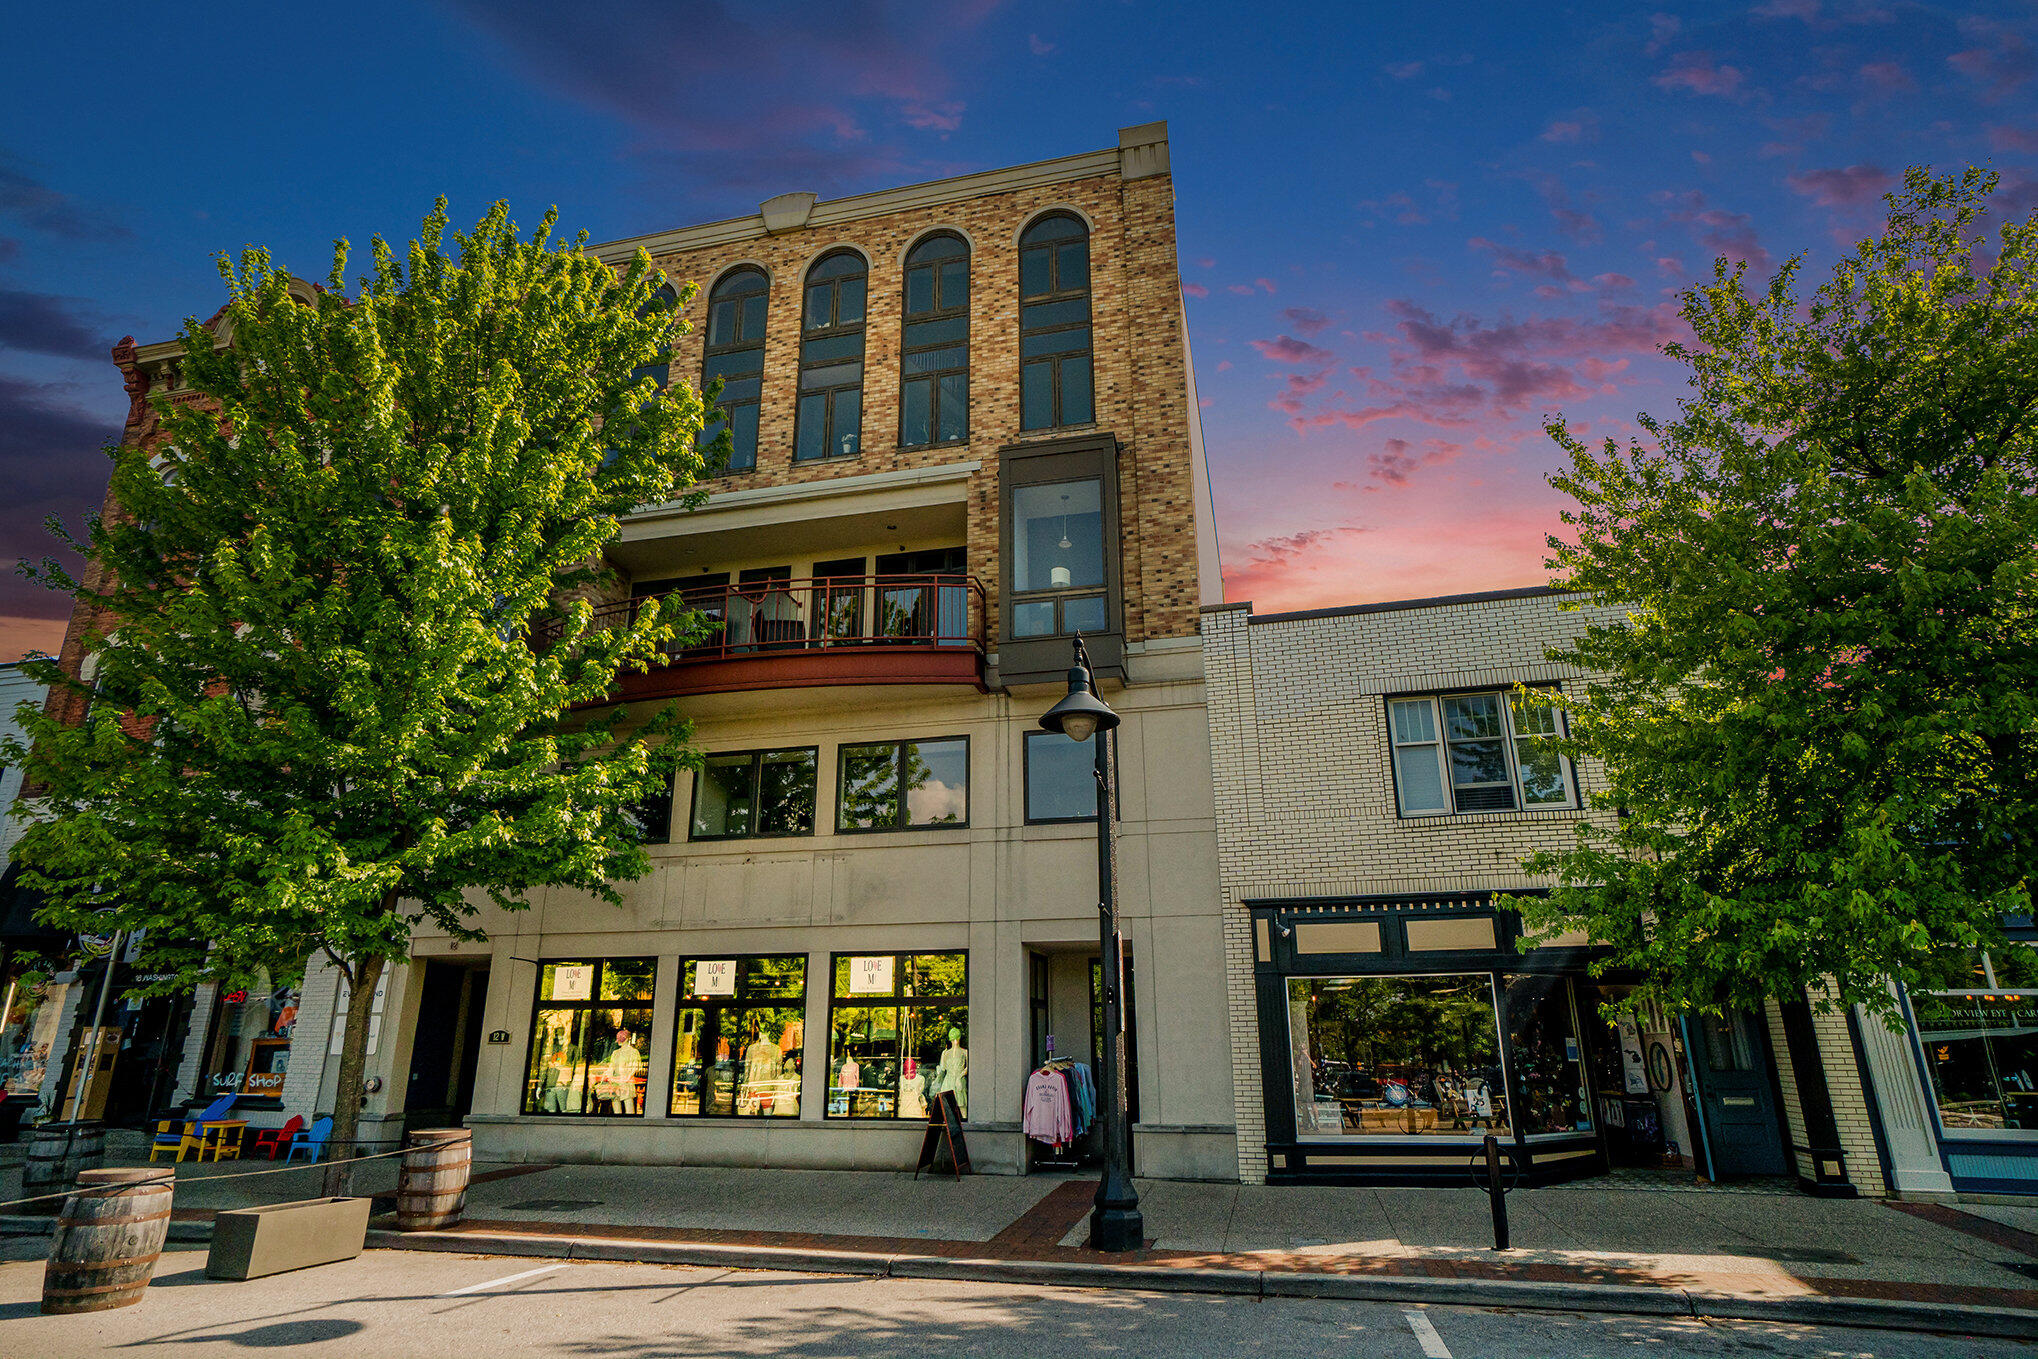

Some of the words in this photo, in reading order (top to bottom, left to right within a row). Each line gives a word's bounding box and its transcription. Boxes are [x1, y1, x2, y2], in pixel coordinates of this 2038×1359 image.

[143, 973, 179, 982] WASHINGTO
[1990, 1009, 2007, 1018] EYE
[2016, 1009, 2038, 1018] CAR
